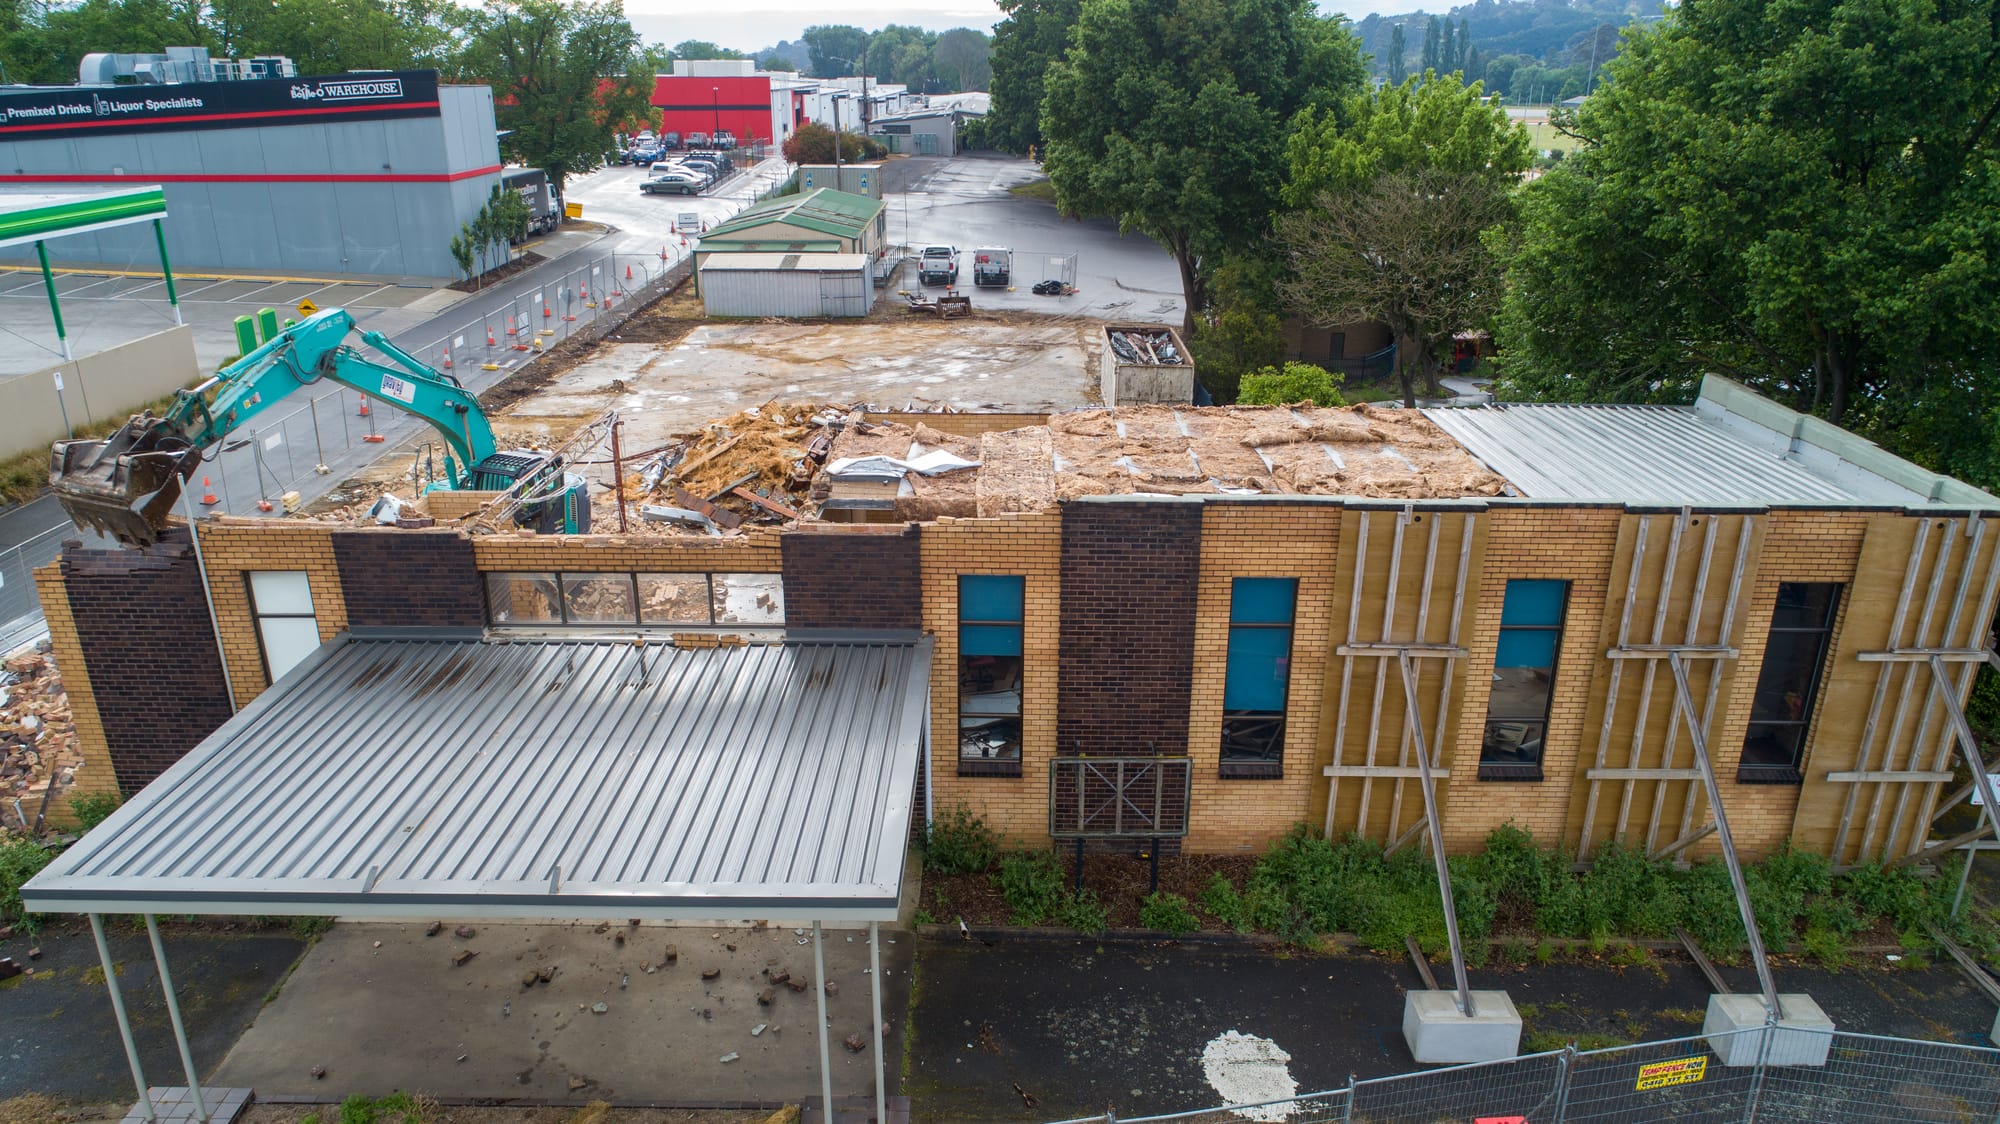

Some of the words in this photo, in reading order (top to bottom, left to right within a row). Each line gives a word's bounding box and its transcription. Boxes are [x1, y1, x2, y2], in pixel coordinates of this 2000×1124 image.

[325, 83, 398, 97] WAREHOUSE
[7, 105, 56, 119] Premixed
[57, 103, 92, 116] Drinks
[109, 101, 145, 113] Liquor
[145, 97, 204, 110] Specialists
